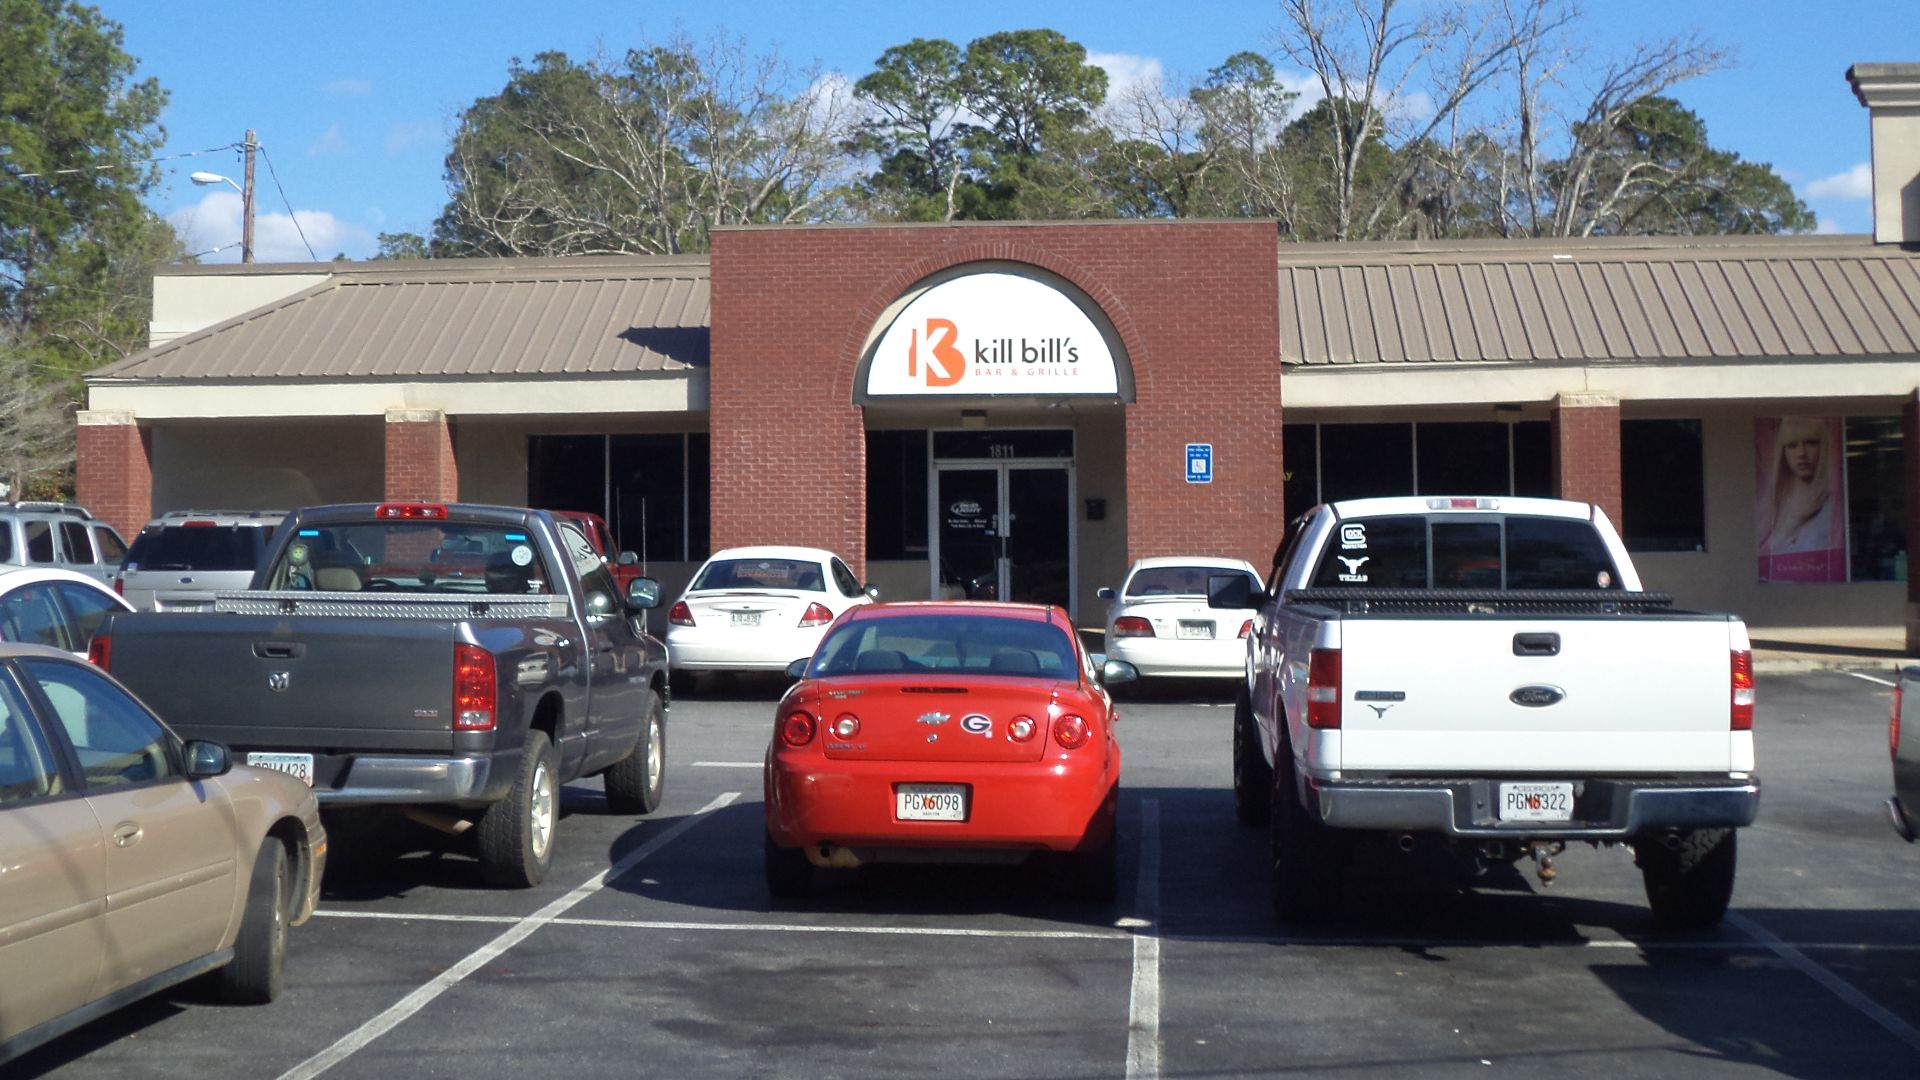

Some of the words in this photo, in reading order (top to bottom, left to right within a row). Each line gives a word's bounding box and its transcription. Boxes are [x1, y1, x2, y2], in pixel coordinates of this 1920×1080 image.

[975, 338, 1013, 364] kill
[1021, 337, 1079, 364] bill's
[975, 368, 1002, 376] BAR
[1011, 368, 1018, 376] &
[1027, 368, 1079, 376] GRILLE
[988, 444, 1014, 458] 1811
[1338, 574, 1369, 582] TEXAS
[904, 794, 959, 811] PGX6098
[1507, 793, 1566, 810] PGM8322
